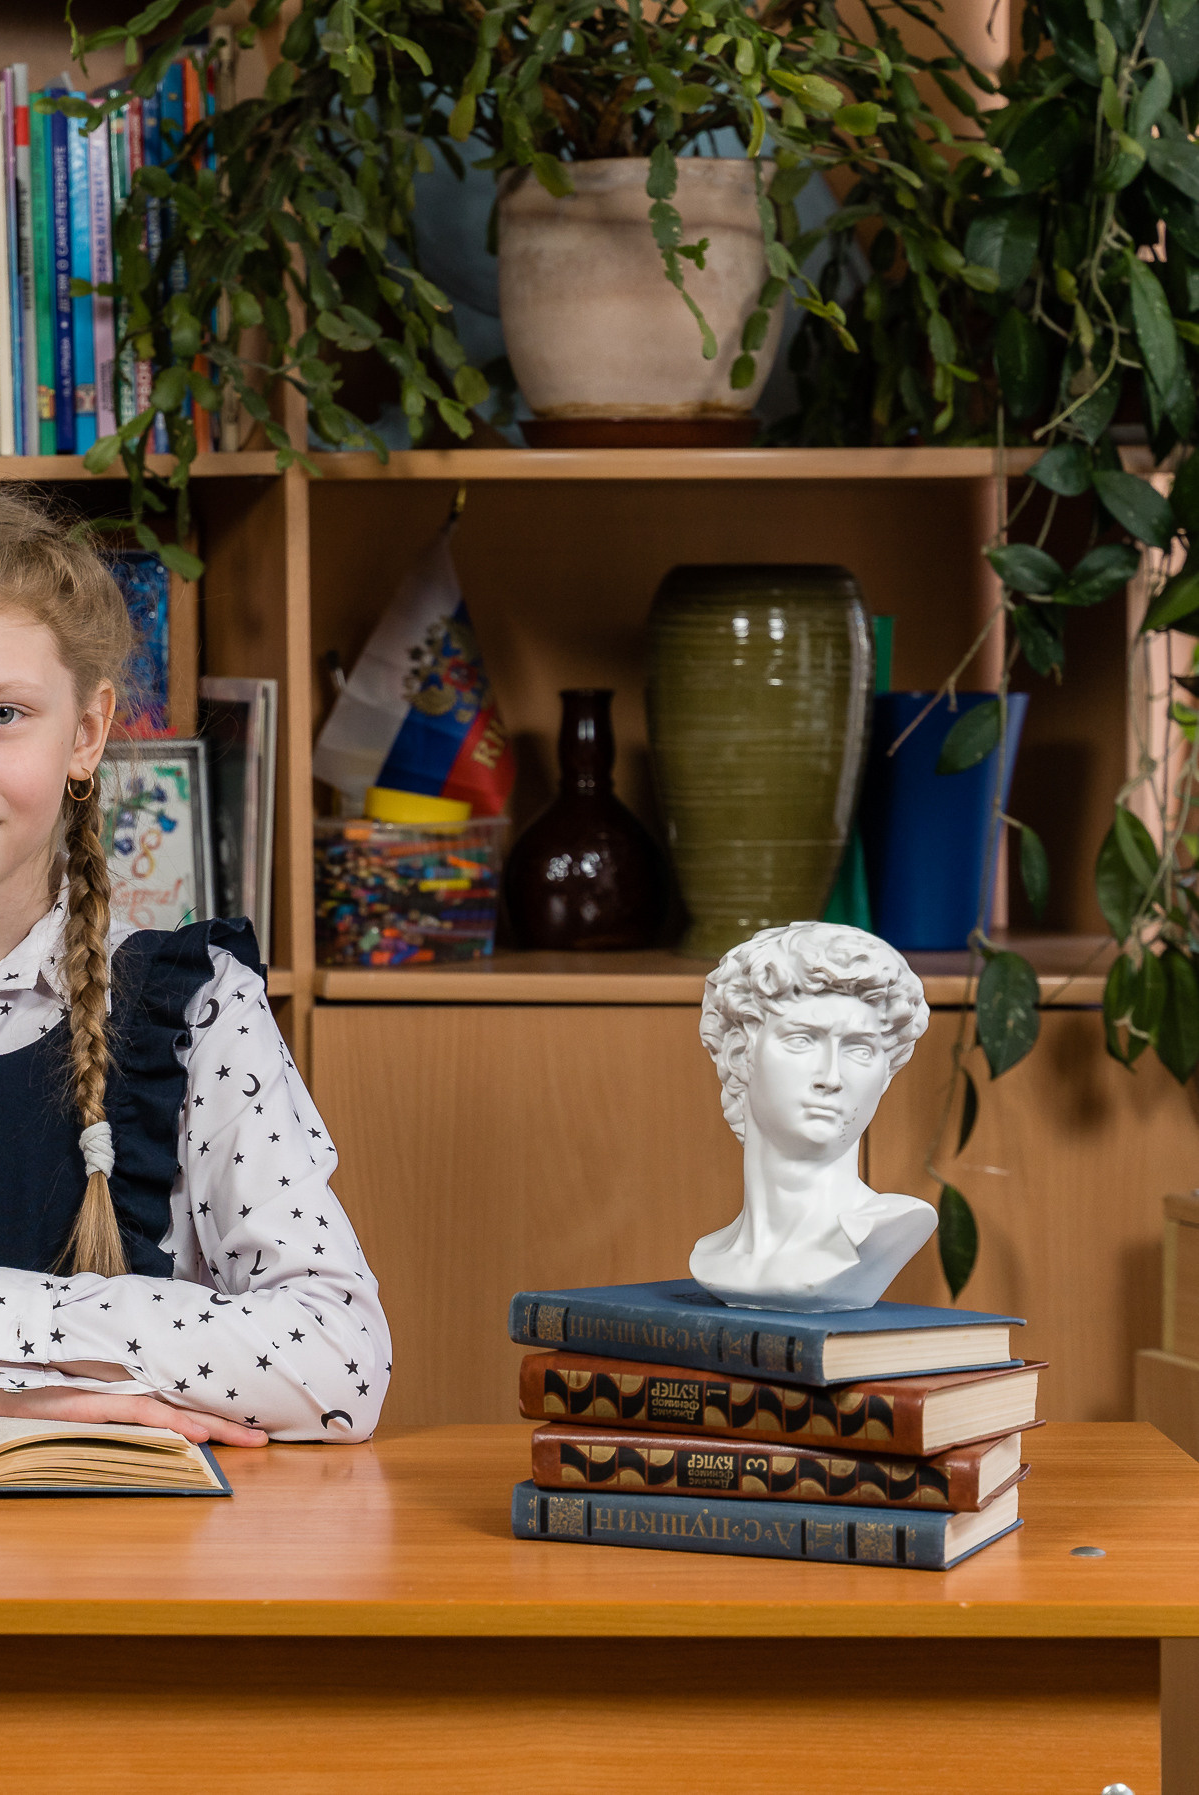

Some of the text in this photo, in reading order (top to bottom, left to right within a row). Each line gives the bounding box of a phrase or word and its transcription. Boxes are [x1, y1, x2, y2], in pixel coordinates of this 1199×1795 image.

[651, 1381, 699, 1400] КУПЕР
[651, 1398, 700, 1411] Фенимор
[652, 1407, 695, 1421] Джеймс
[687, 1453, 734, 1470] КУПЕР
[746, 1458, 768, 1471] 3
[688, 1468, 735, 1479] Фенимор
[688, 1476, 730, 1489] Джеймс
